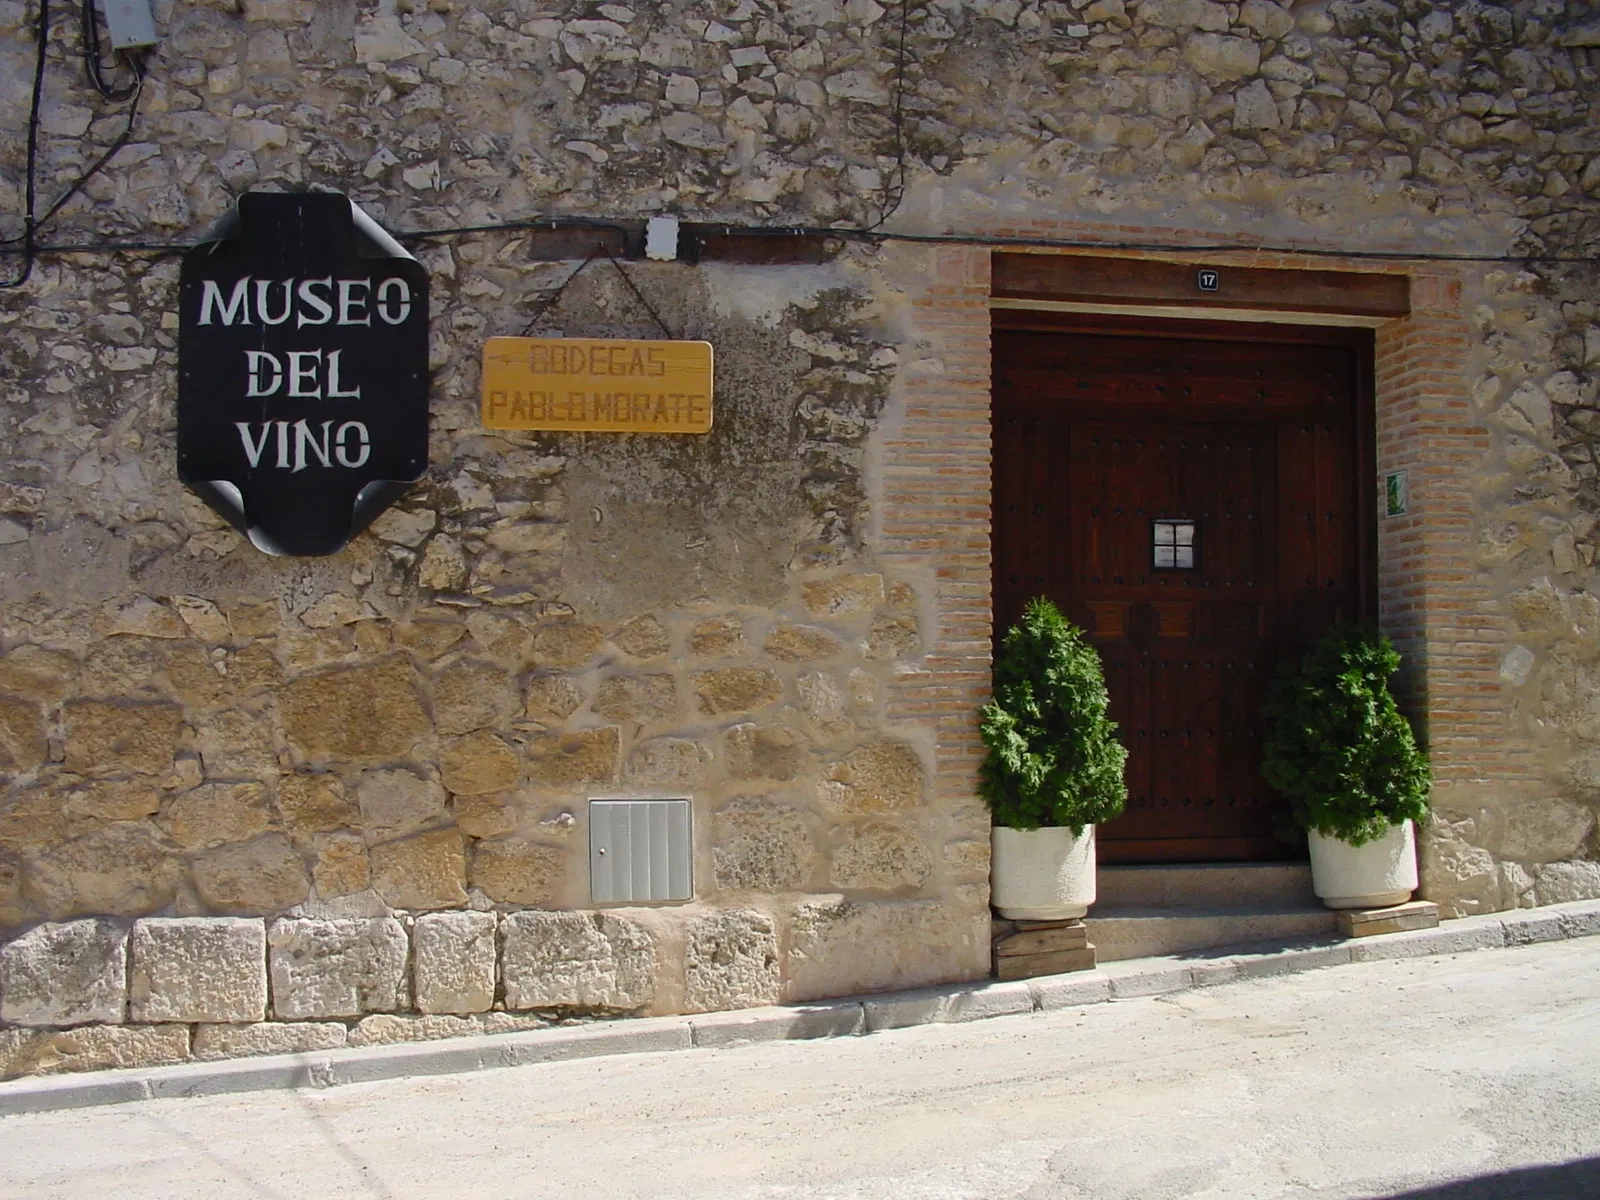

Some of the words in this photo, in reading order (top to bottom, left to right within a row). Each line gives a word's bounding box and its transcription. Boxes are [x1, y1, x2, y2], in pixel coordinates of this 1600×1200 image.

[197, 275, 411, 328] MUSEO
[1202, 274, 1215, 286] 17
[245, 348, 361, 400] DEL
[530, 344, 665, 377] BODEGAS
[488, 391, 586, 422] PABLO
[593, 392, 705, 425] MORATE
[234, 419, 371, 474] VINO
